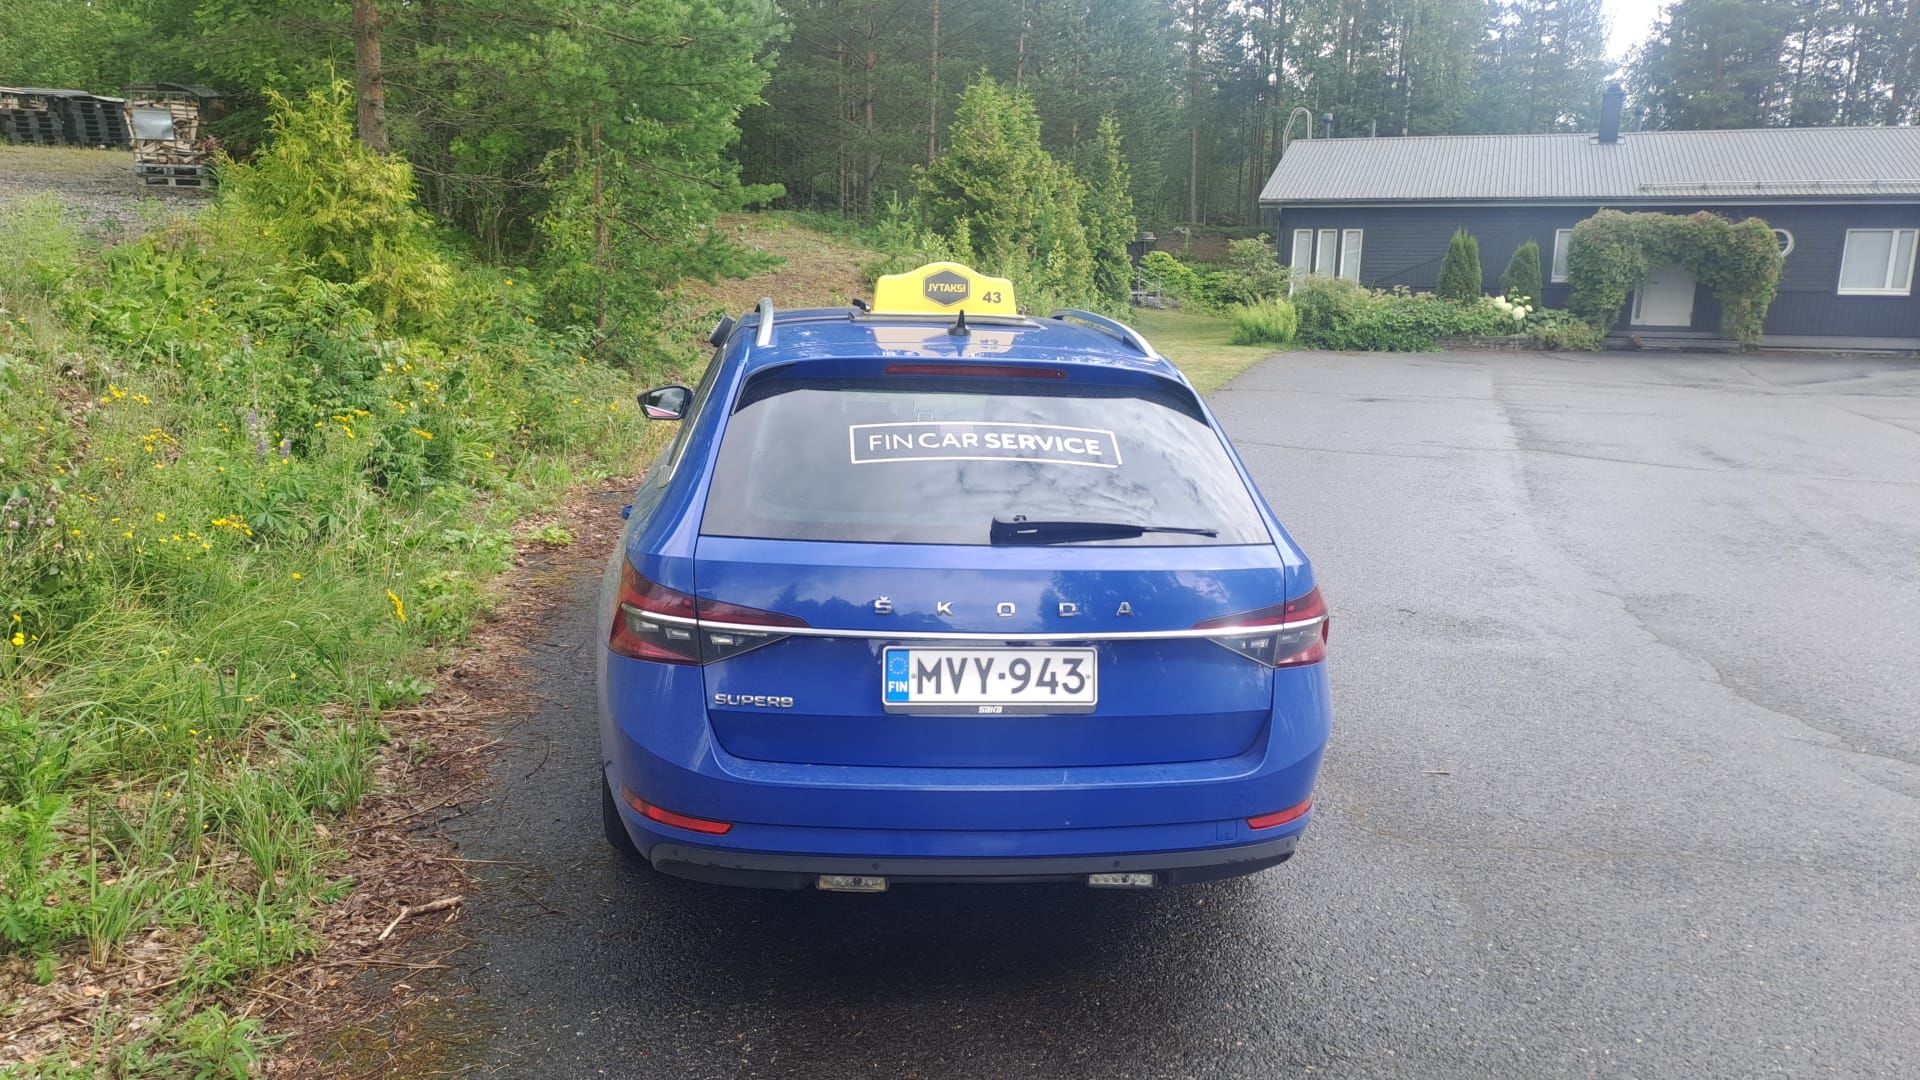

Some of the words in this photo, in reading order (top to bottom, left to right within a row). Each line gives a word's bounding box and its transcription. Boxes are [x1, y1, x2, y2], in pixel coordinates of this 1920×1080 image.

[928, 283, 966, 293] JYTAKSI
[982, 291, 1002, 304] 43
[983, 432, 1103, 456] SERVICE
[874, 596, 1134, 617] ŠKODA
[916, 657, 1086, 695] MVY-943
[888, 681, 909, 693] FIN
[714, 693, 794, 708] SUPERB
